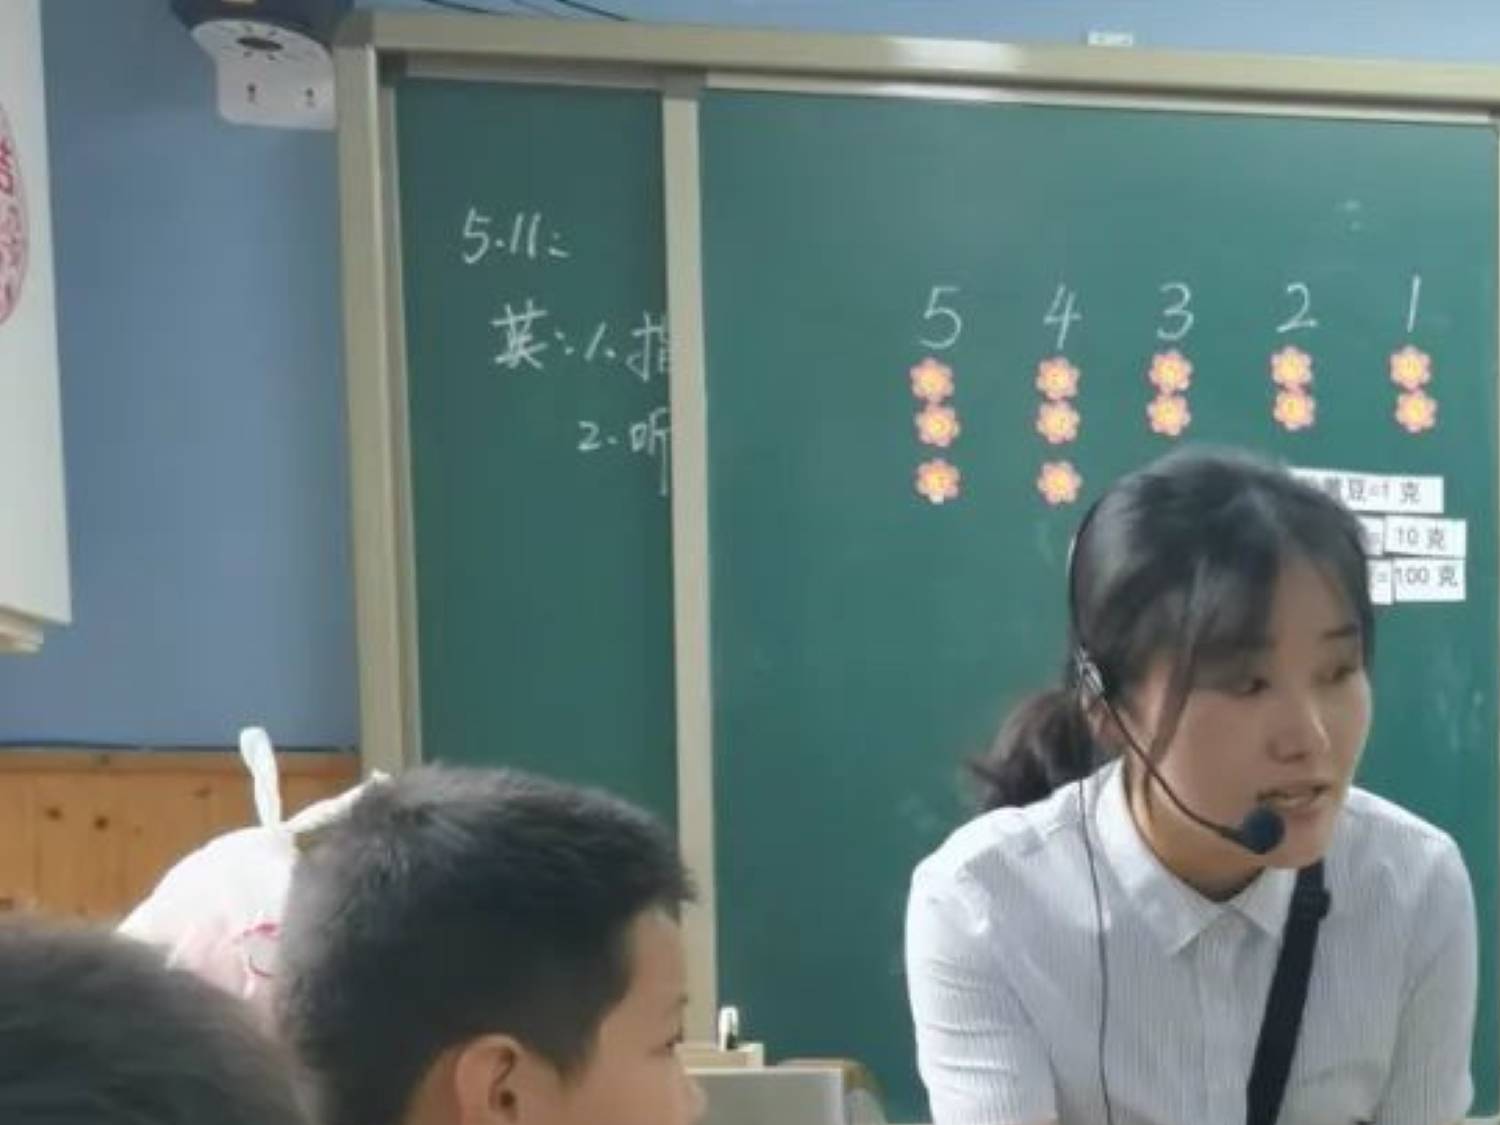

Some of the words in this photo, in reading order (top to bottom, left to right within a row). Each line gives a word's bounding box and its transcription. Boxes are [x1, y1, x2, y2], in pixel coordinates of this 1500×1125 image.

[917, 285, 963, 350] 5
[1042, 283, 1082, 350] 4
[1156, 282, 1195, 340] 3
[1276, 282, 1319, 333] 2
[1407, 274, 1422, 334] 1
